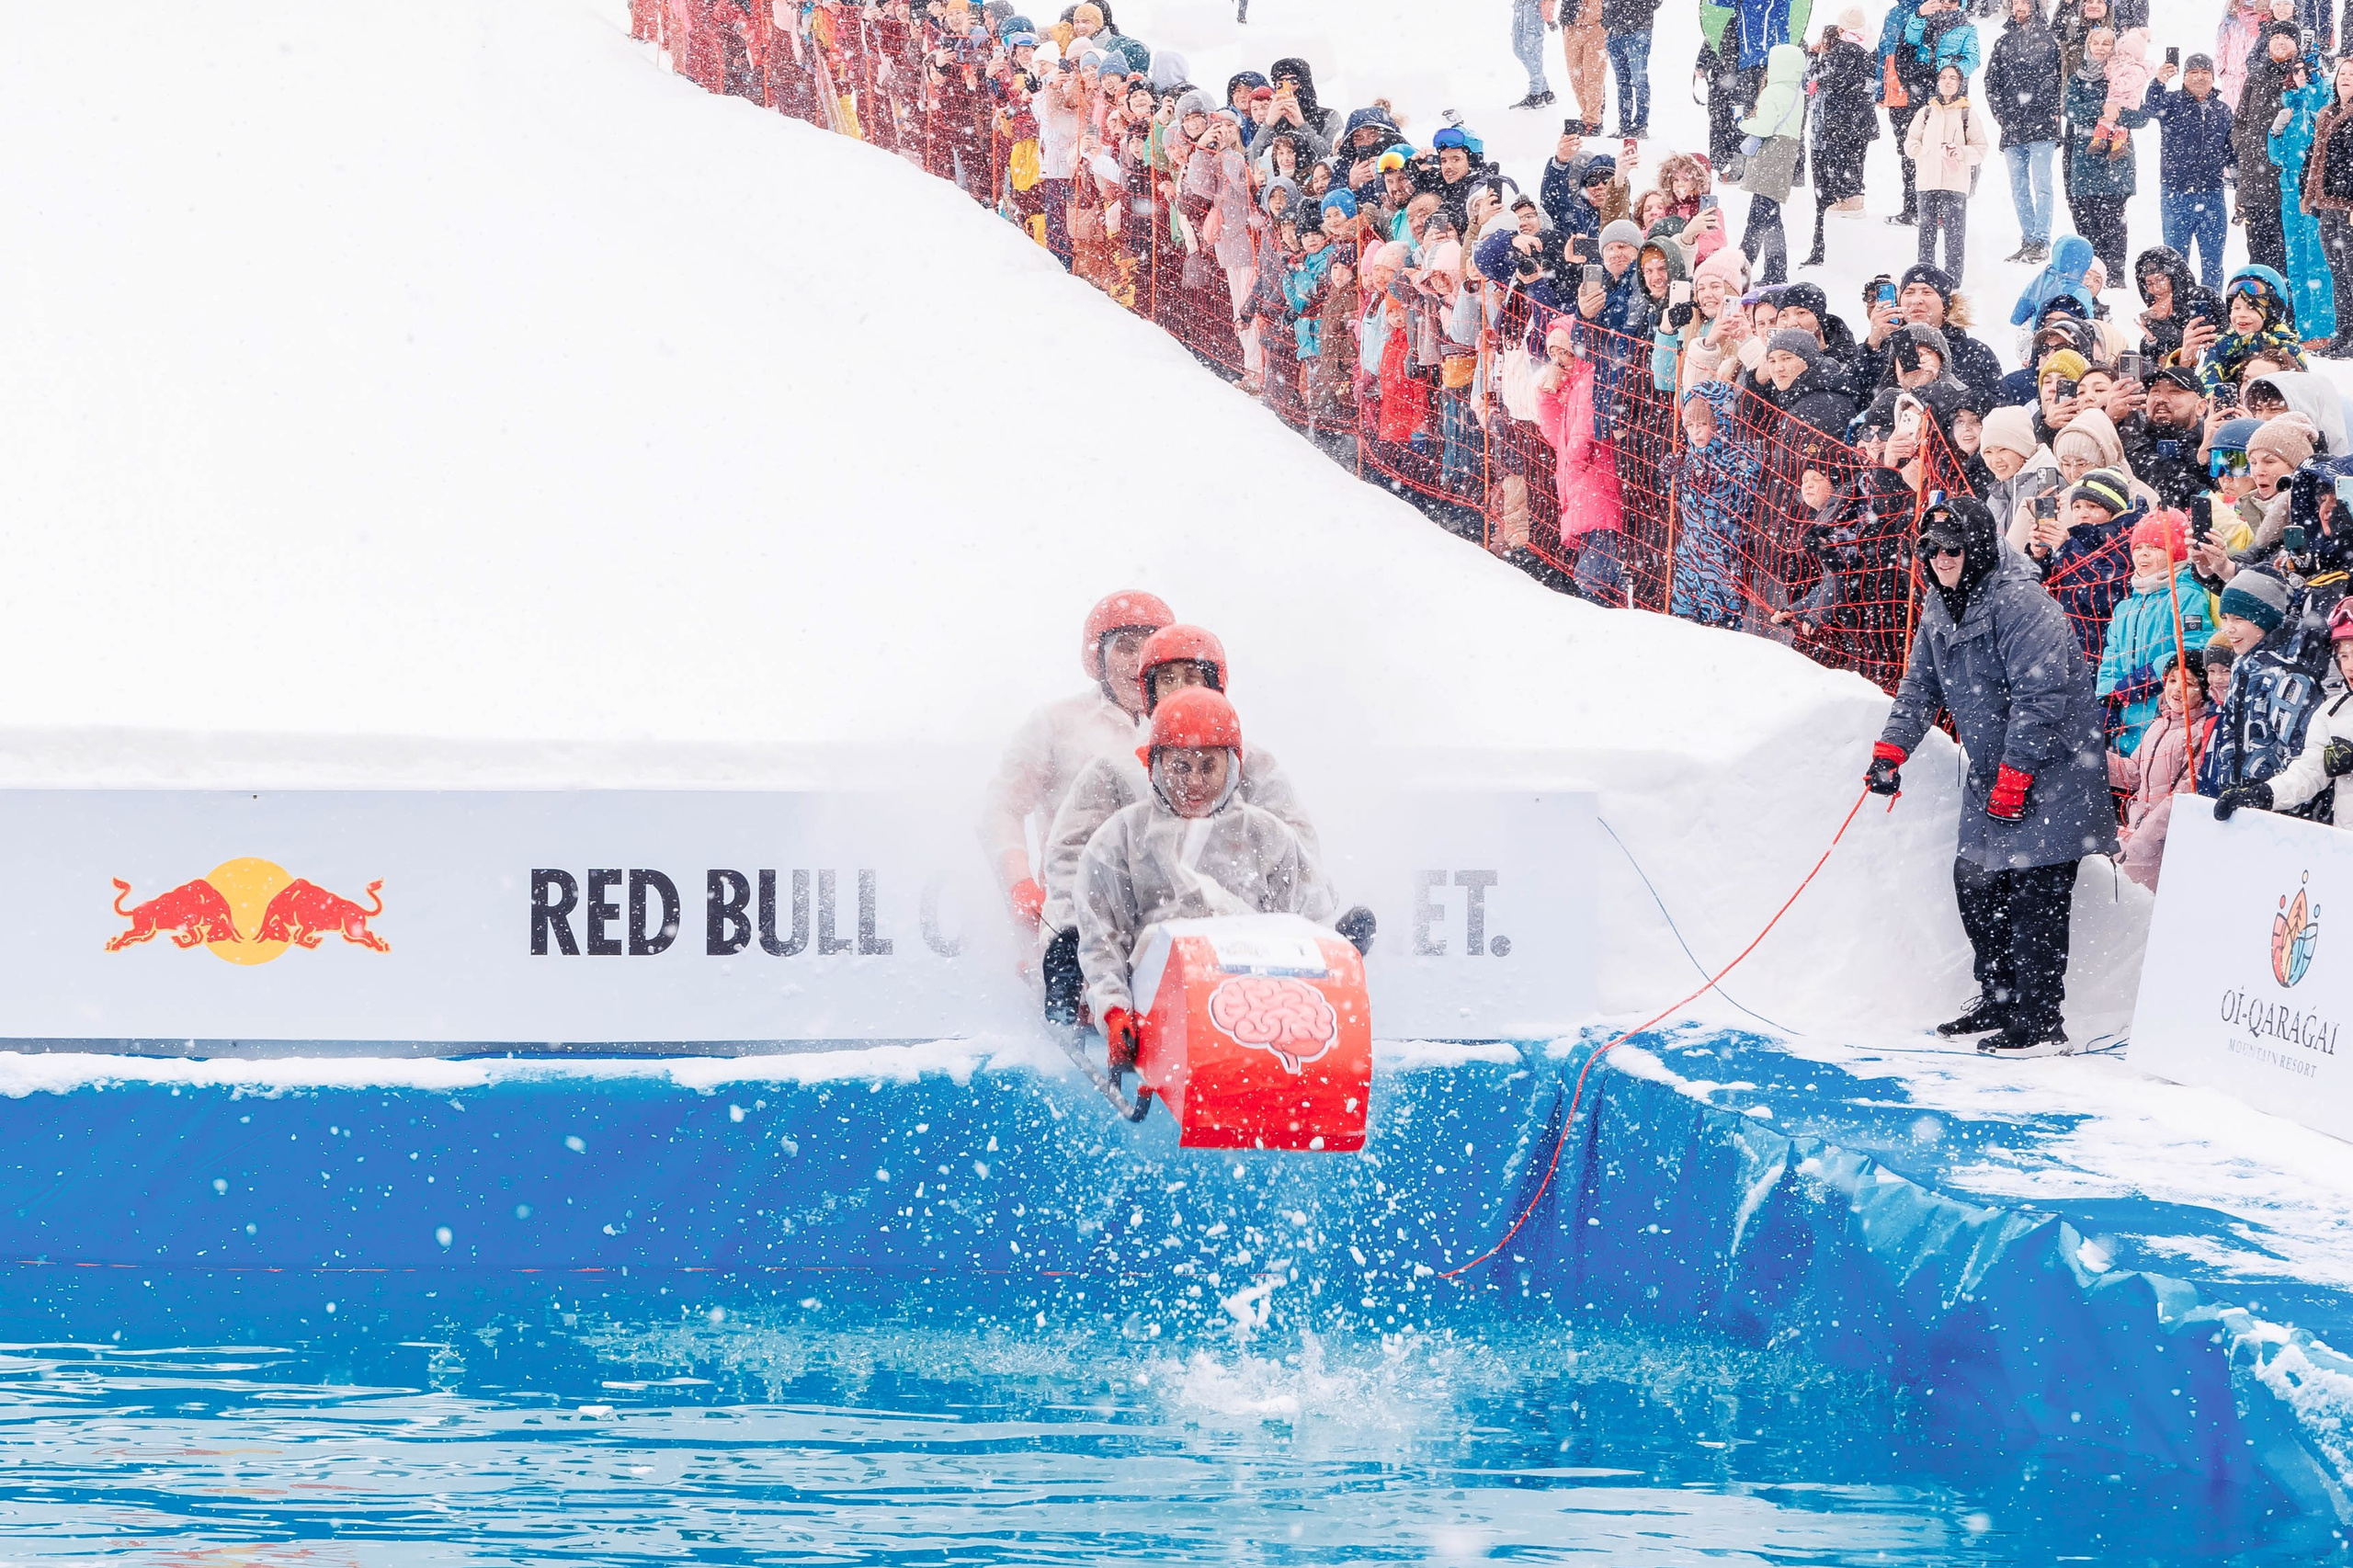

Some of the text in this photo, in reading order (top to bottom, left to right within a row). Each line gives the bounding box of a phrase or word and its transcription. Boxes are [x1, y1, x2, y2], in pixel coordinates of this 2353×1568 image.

[530, 869, 681, 956] RED
[706, 869, 893, 957] BULL
[2279, 1054, 2317, 1078] RESORT
